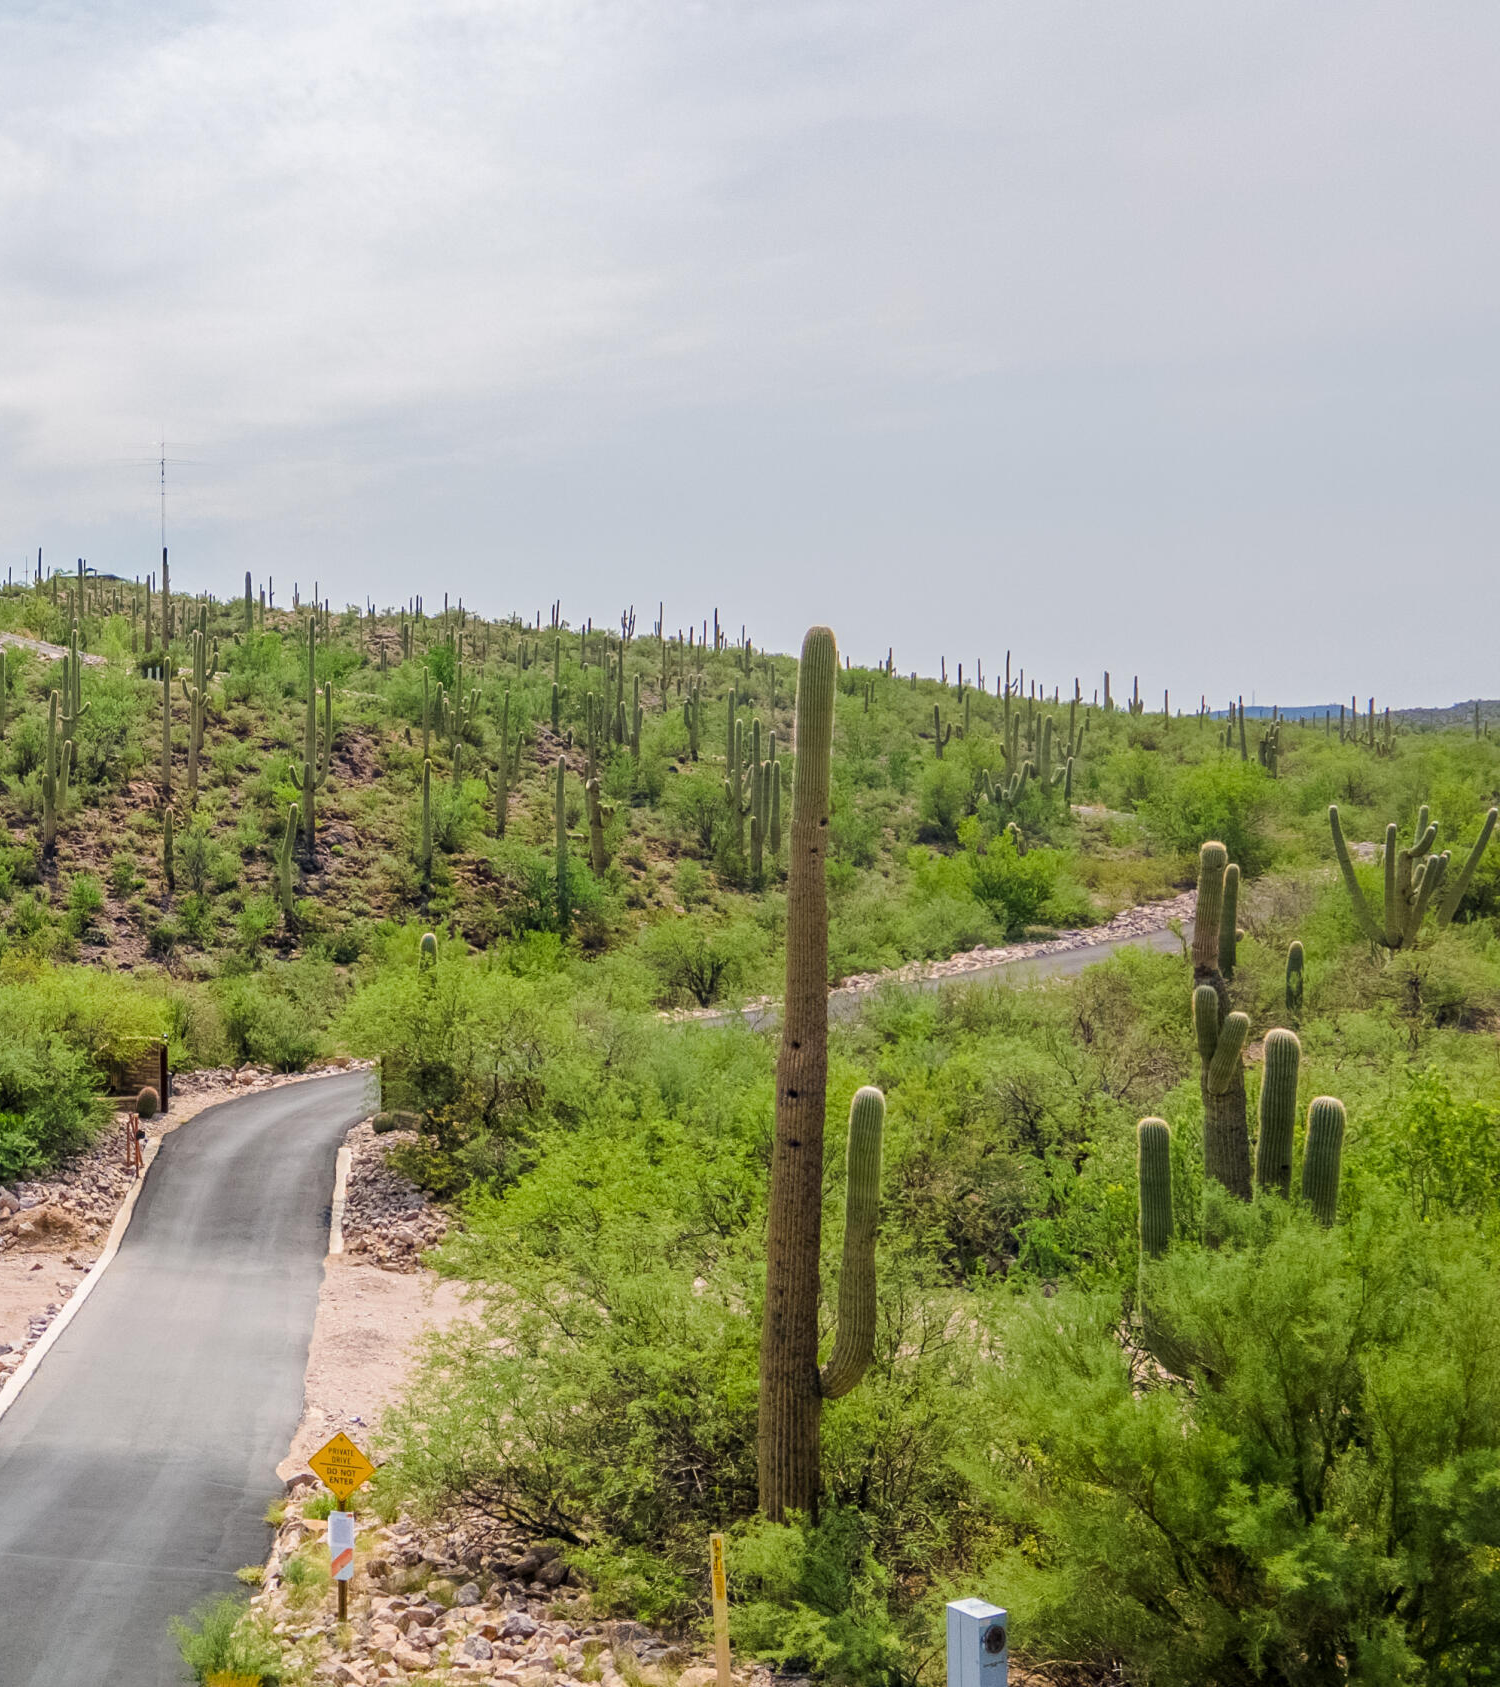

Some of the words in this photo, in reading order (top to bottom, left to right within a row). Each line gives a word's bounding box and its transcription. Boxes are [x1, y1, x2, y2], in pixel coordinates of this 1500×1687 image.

[328, 1448, 354, 1456] PRIVATE
[331, 1456, 351, 1464] DRIVE
[326, 1467, 338, 1475] DO
[340, 1469, 356, 1477] NOT
[329, 1477, 354, 1485] ENTER
